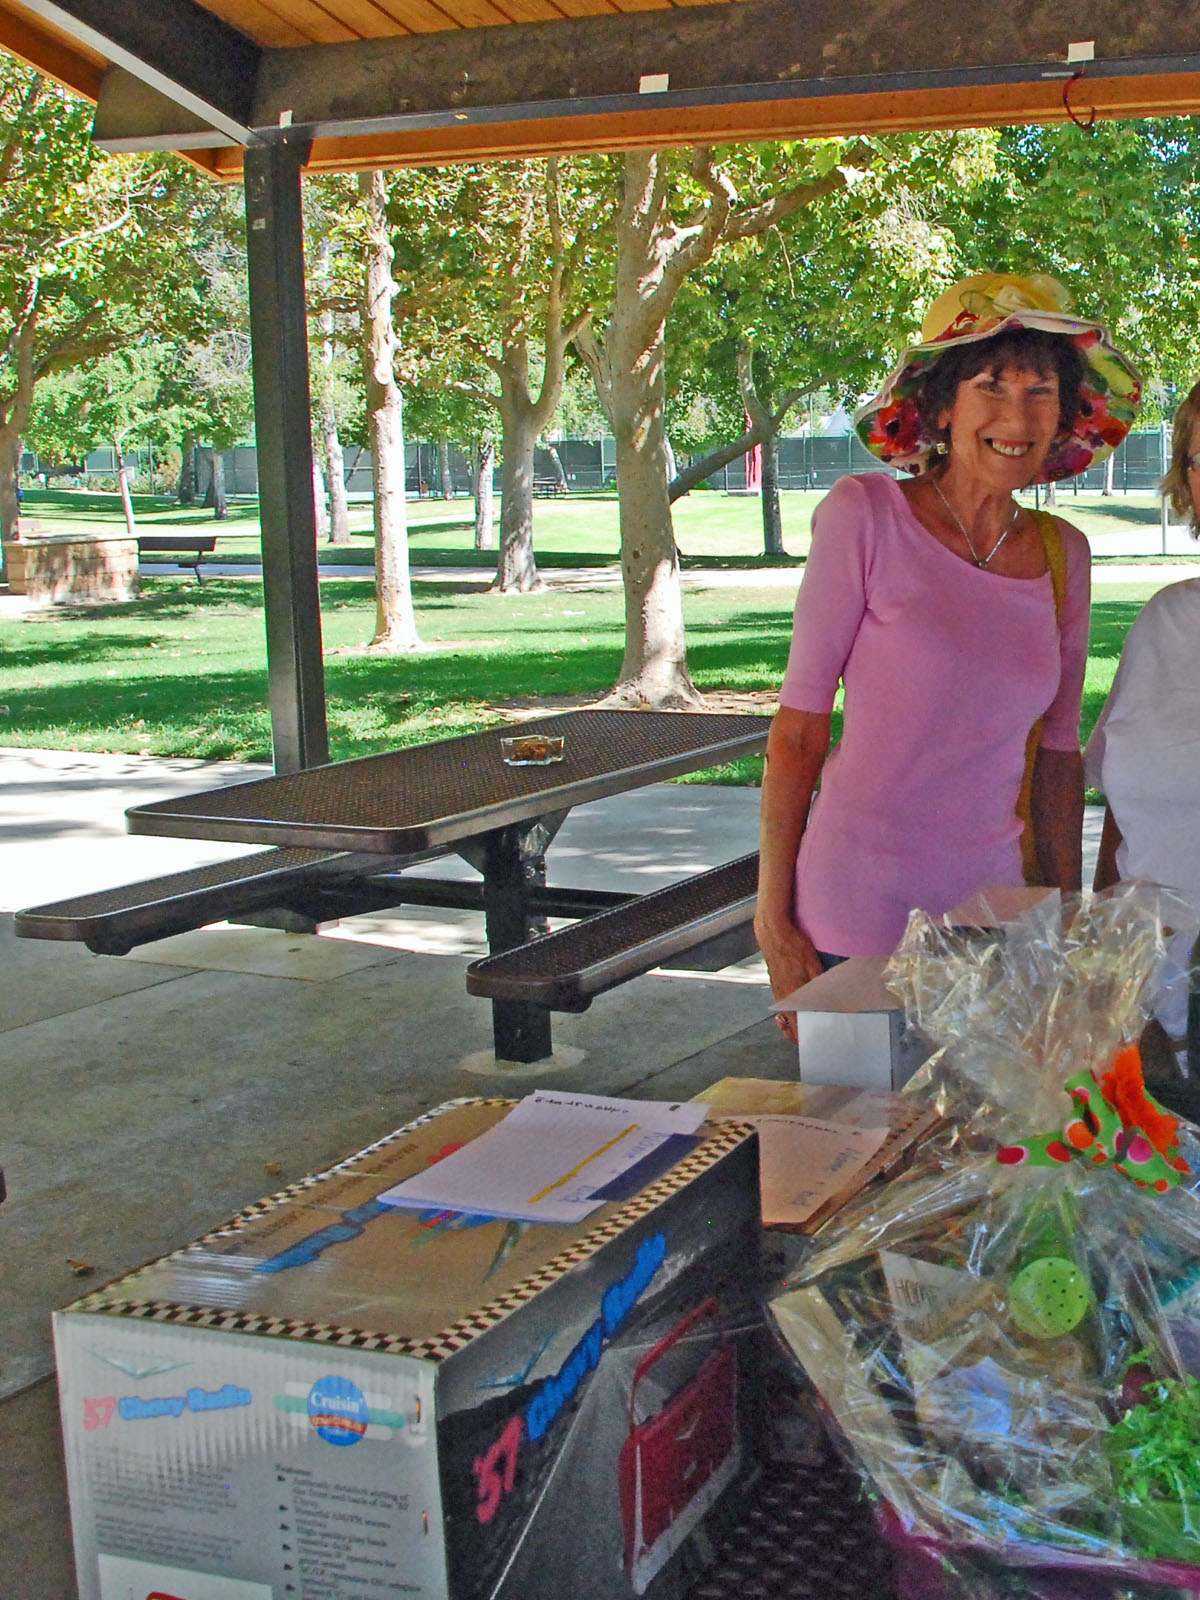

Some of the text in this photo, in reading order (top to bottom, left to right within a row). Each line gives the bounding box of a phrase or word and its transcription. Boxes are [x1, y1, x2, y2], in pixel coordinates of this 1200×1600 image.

[83, 1396, 117, 1431] 57
[311, 1391, 364, 1413] Cruisin'
[474, 1415, 522, 1523] 57
